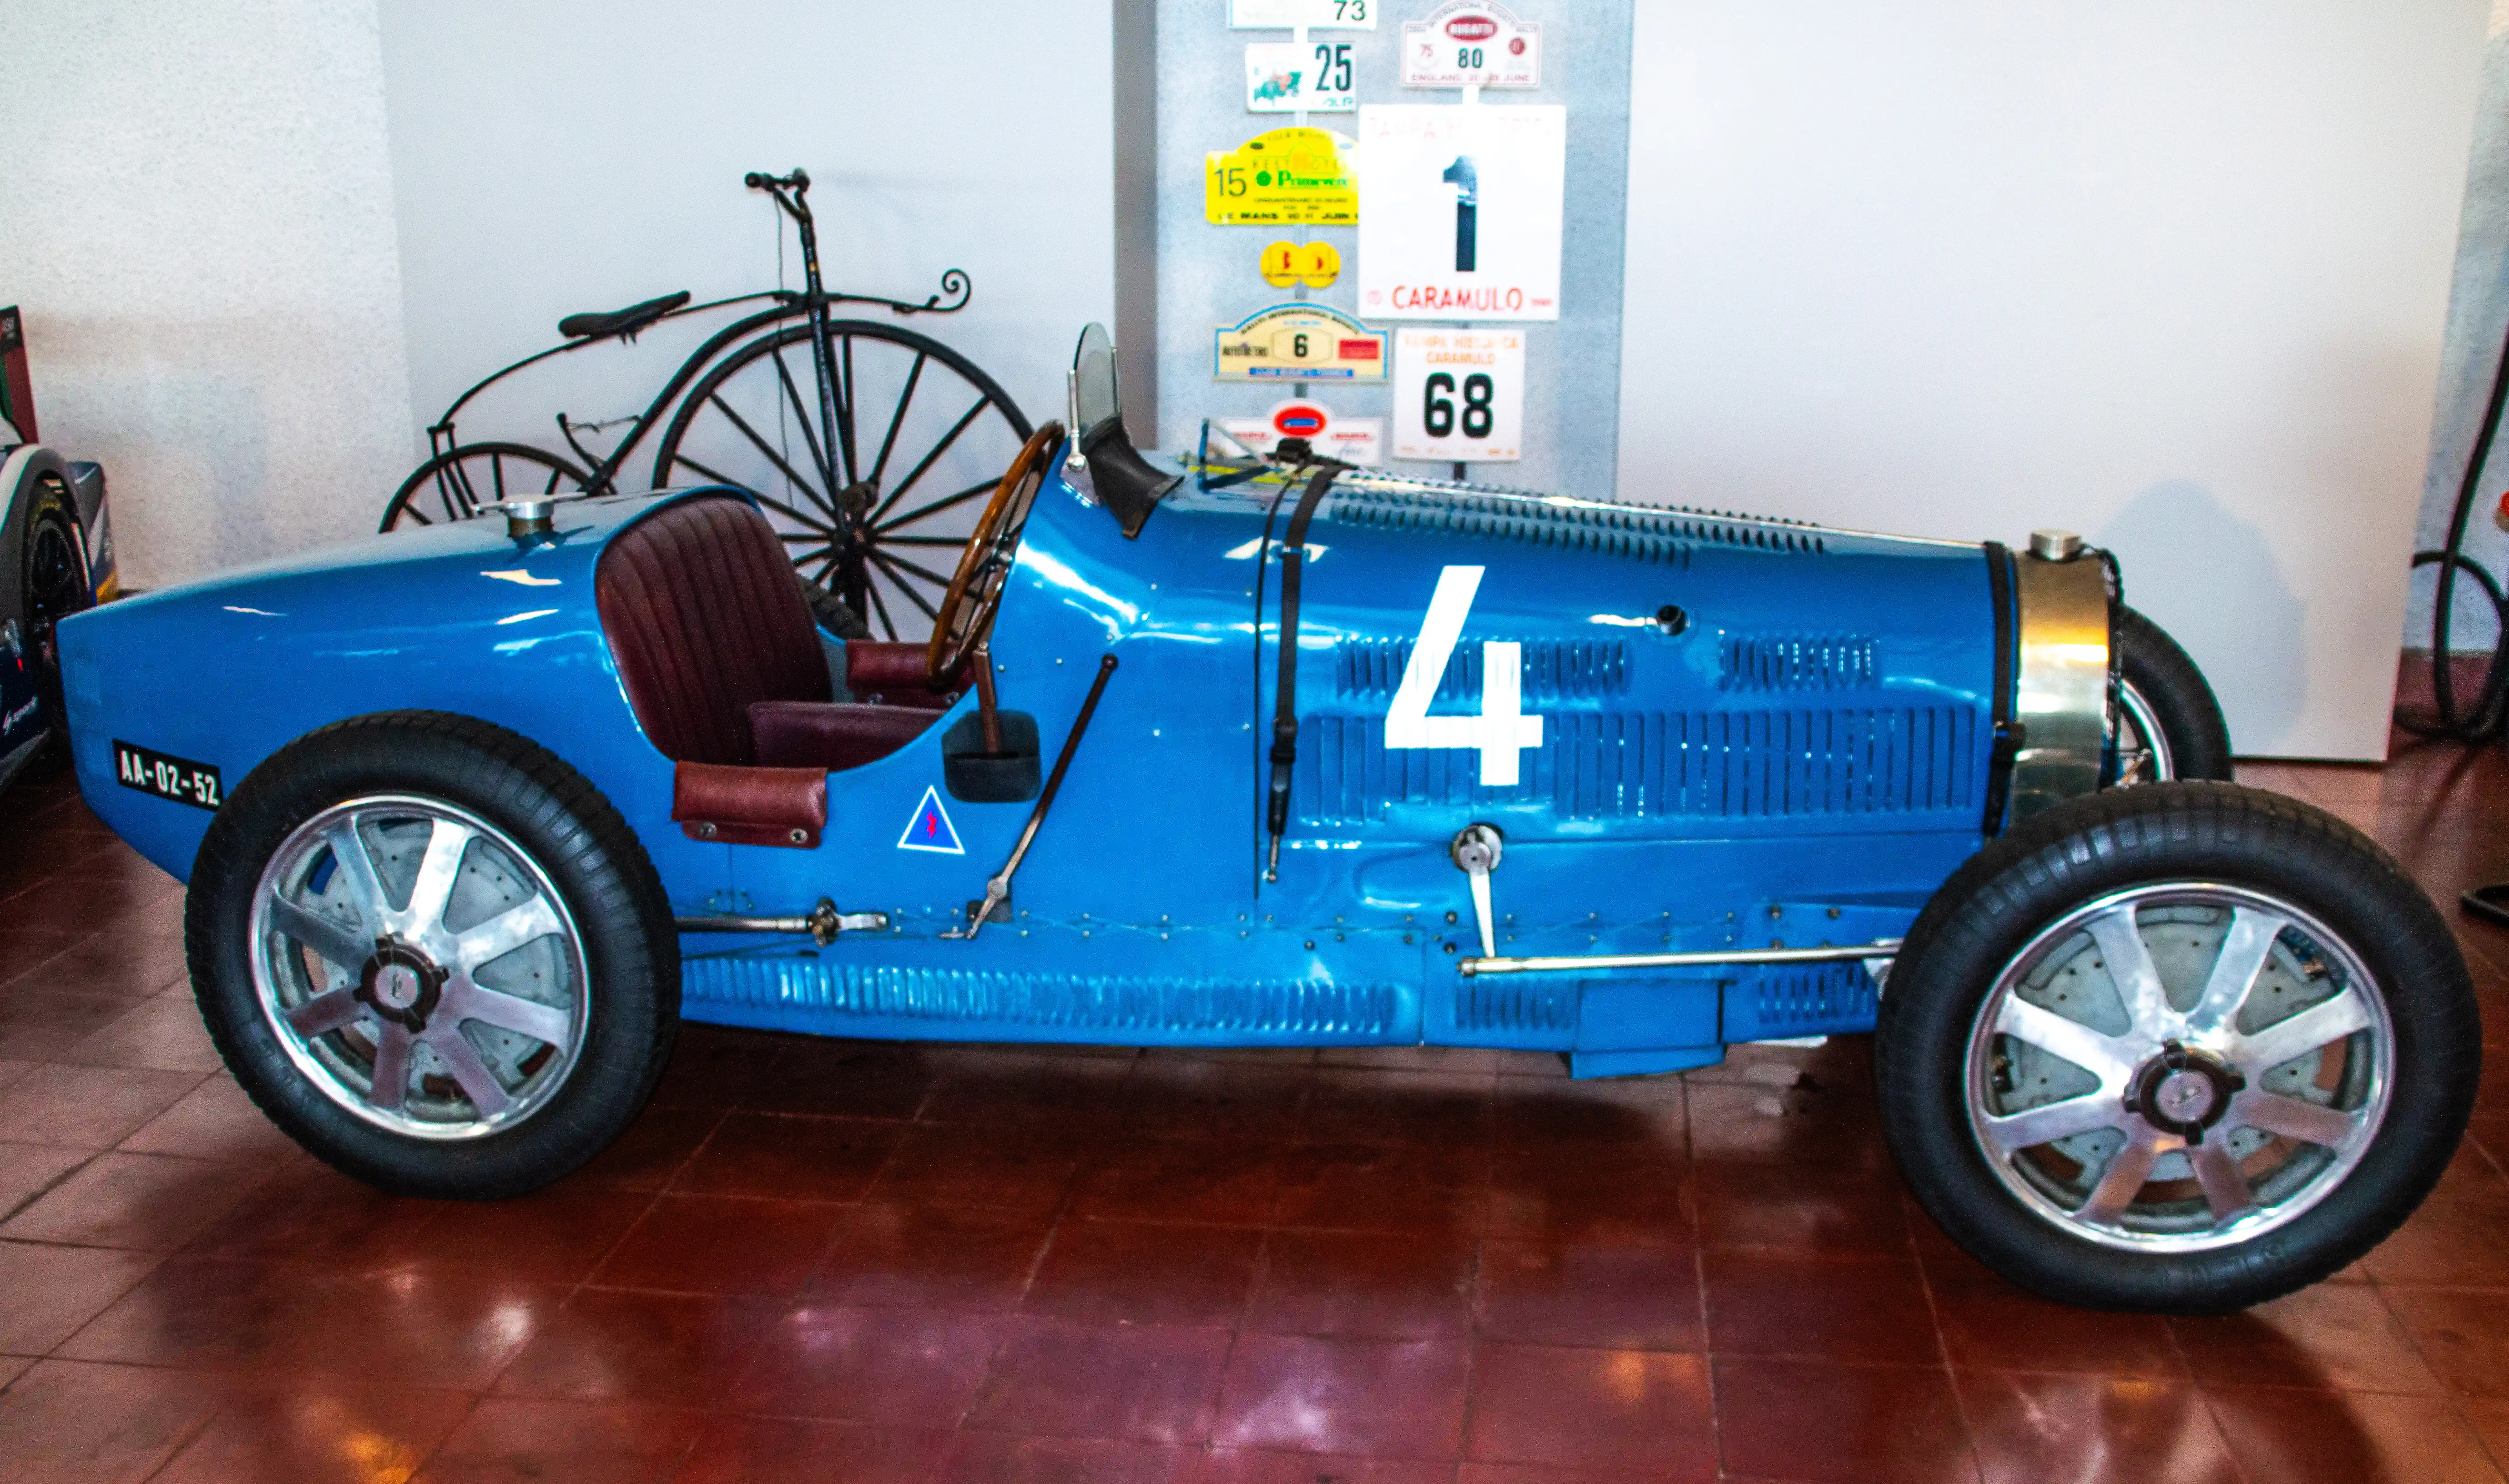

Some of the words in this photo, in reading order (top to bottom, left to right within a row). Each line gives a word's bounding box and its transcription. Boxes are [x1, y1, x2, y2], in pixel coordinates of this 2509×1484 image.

[1333, 0, 1366, 21] 73
[1315, 44, 1352, 91] 25
[1458, 47, 1483, 69] 80
[1214, 167, 1247, 197] 15
[1443, 155, 1479, 272] 1
[1392, 285, 1523, 312] CARAMULO
[1294, 333, 1308, 357] 6
[1424, 371, 1494, 439] 68
[1385, 565, 1544, 786] 4
[120, 749, 221, 806] AA-02-52
